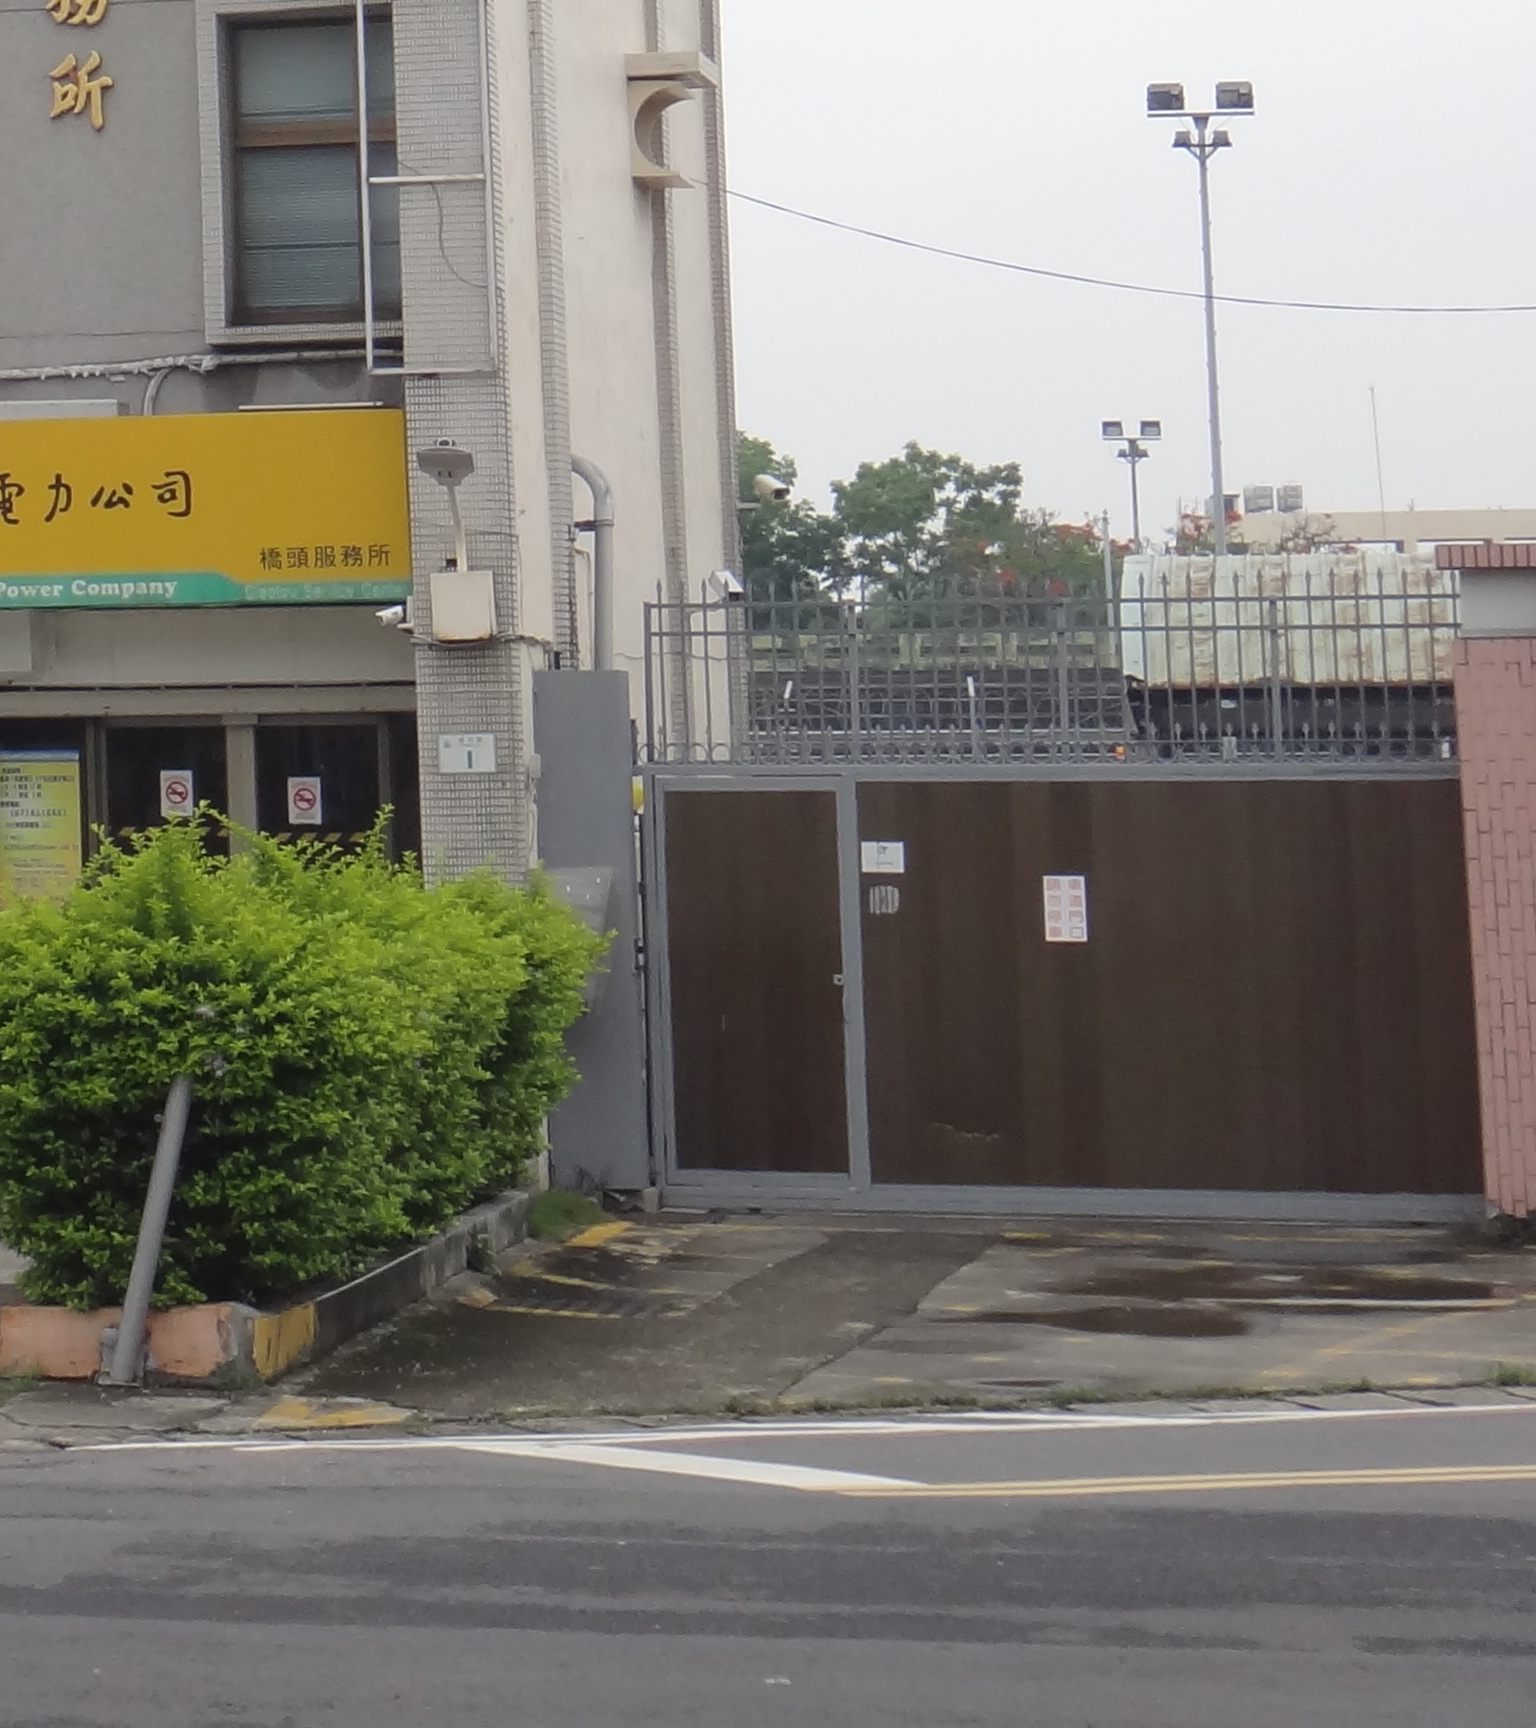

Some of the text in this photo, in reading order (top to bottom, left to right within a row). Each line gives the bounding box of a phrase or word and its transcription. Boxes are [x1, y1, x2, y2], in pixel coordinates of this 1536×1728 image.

[259, 543, 391, 572] 橋頭服務所
[70, 578, 178, 600] Company
